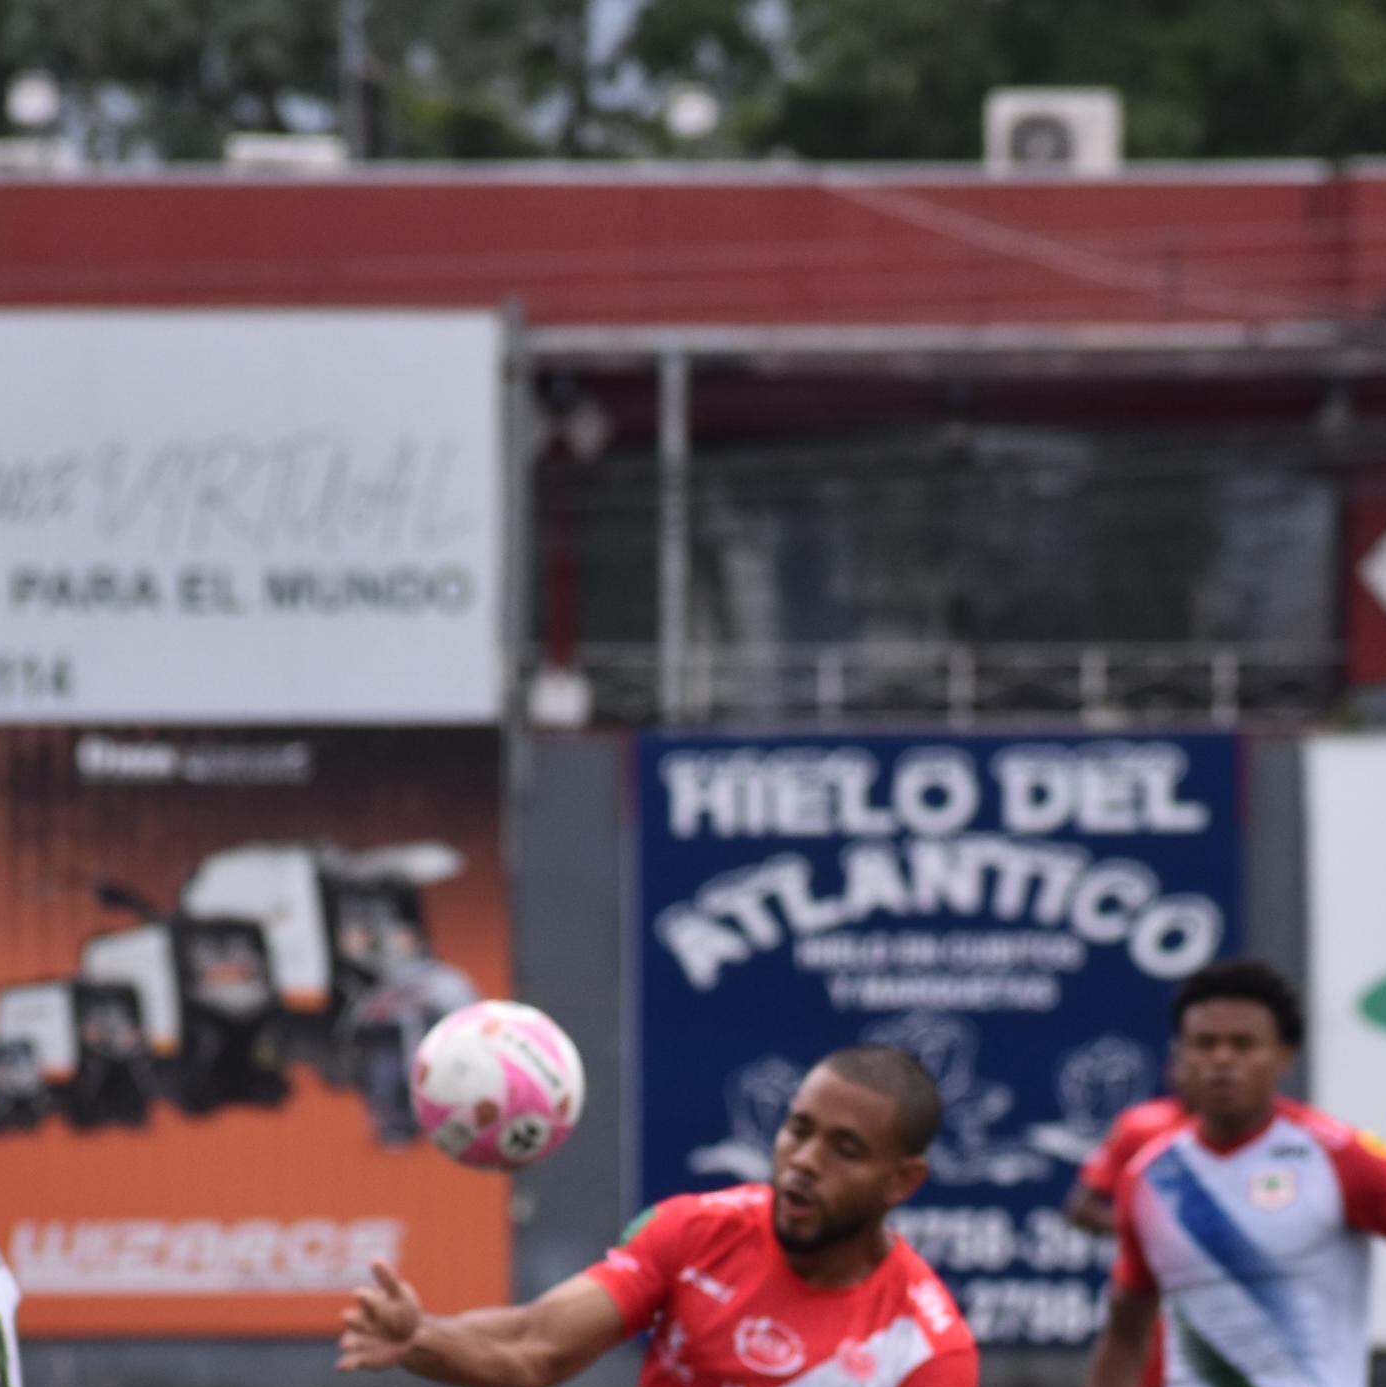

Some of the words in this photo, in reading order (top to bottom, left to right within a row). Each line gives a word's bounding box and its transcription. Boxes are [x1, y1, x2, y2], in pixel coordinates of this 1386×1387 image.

[12, 565, 161, 614] PARA
[175, 565, 247, 616] EL
[264, 564, 477, 617] MUNDO
[661, 745, 981, 840] HIELO
[993, 741, 1211, 836] DEL
[655, 834, 1225, 992] ATLANTICO
